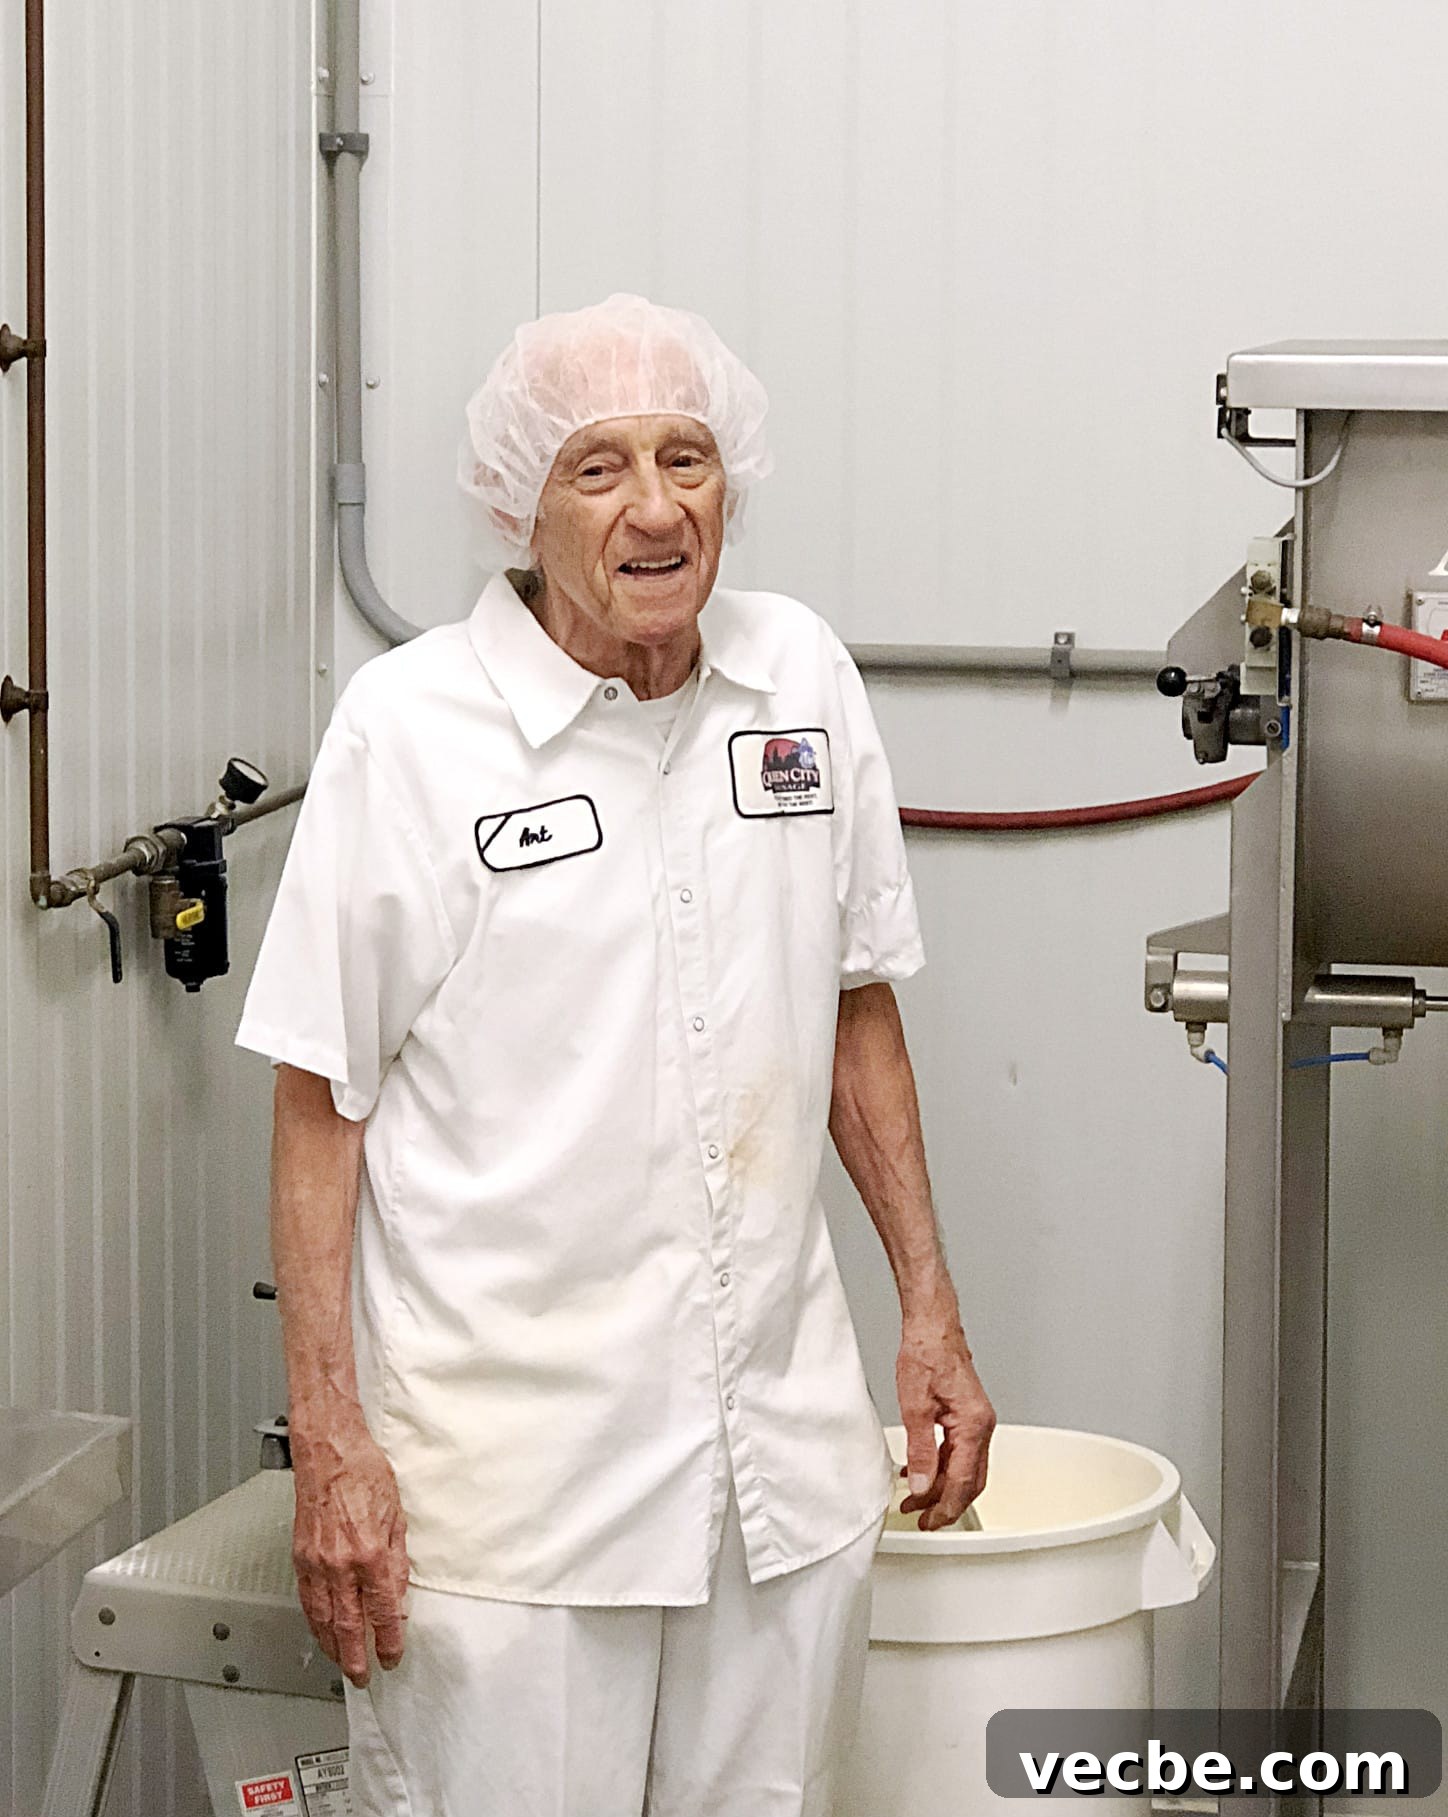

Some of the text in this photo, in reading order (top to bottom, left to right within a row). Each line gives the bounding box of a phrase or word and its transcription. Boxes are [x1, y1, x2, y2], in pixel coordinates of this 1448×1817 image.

[790, 768, 819, 783] CITY
[519, 825, 553, 848] Art
[247, 1780, 286, 1796] SAFETY
[254, 1791, 284, 1805] FIRST
